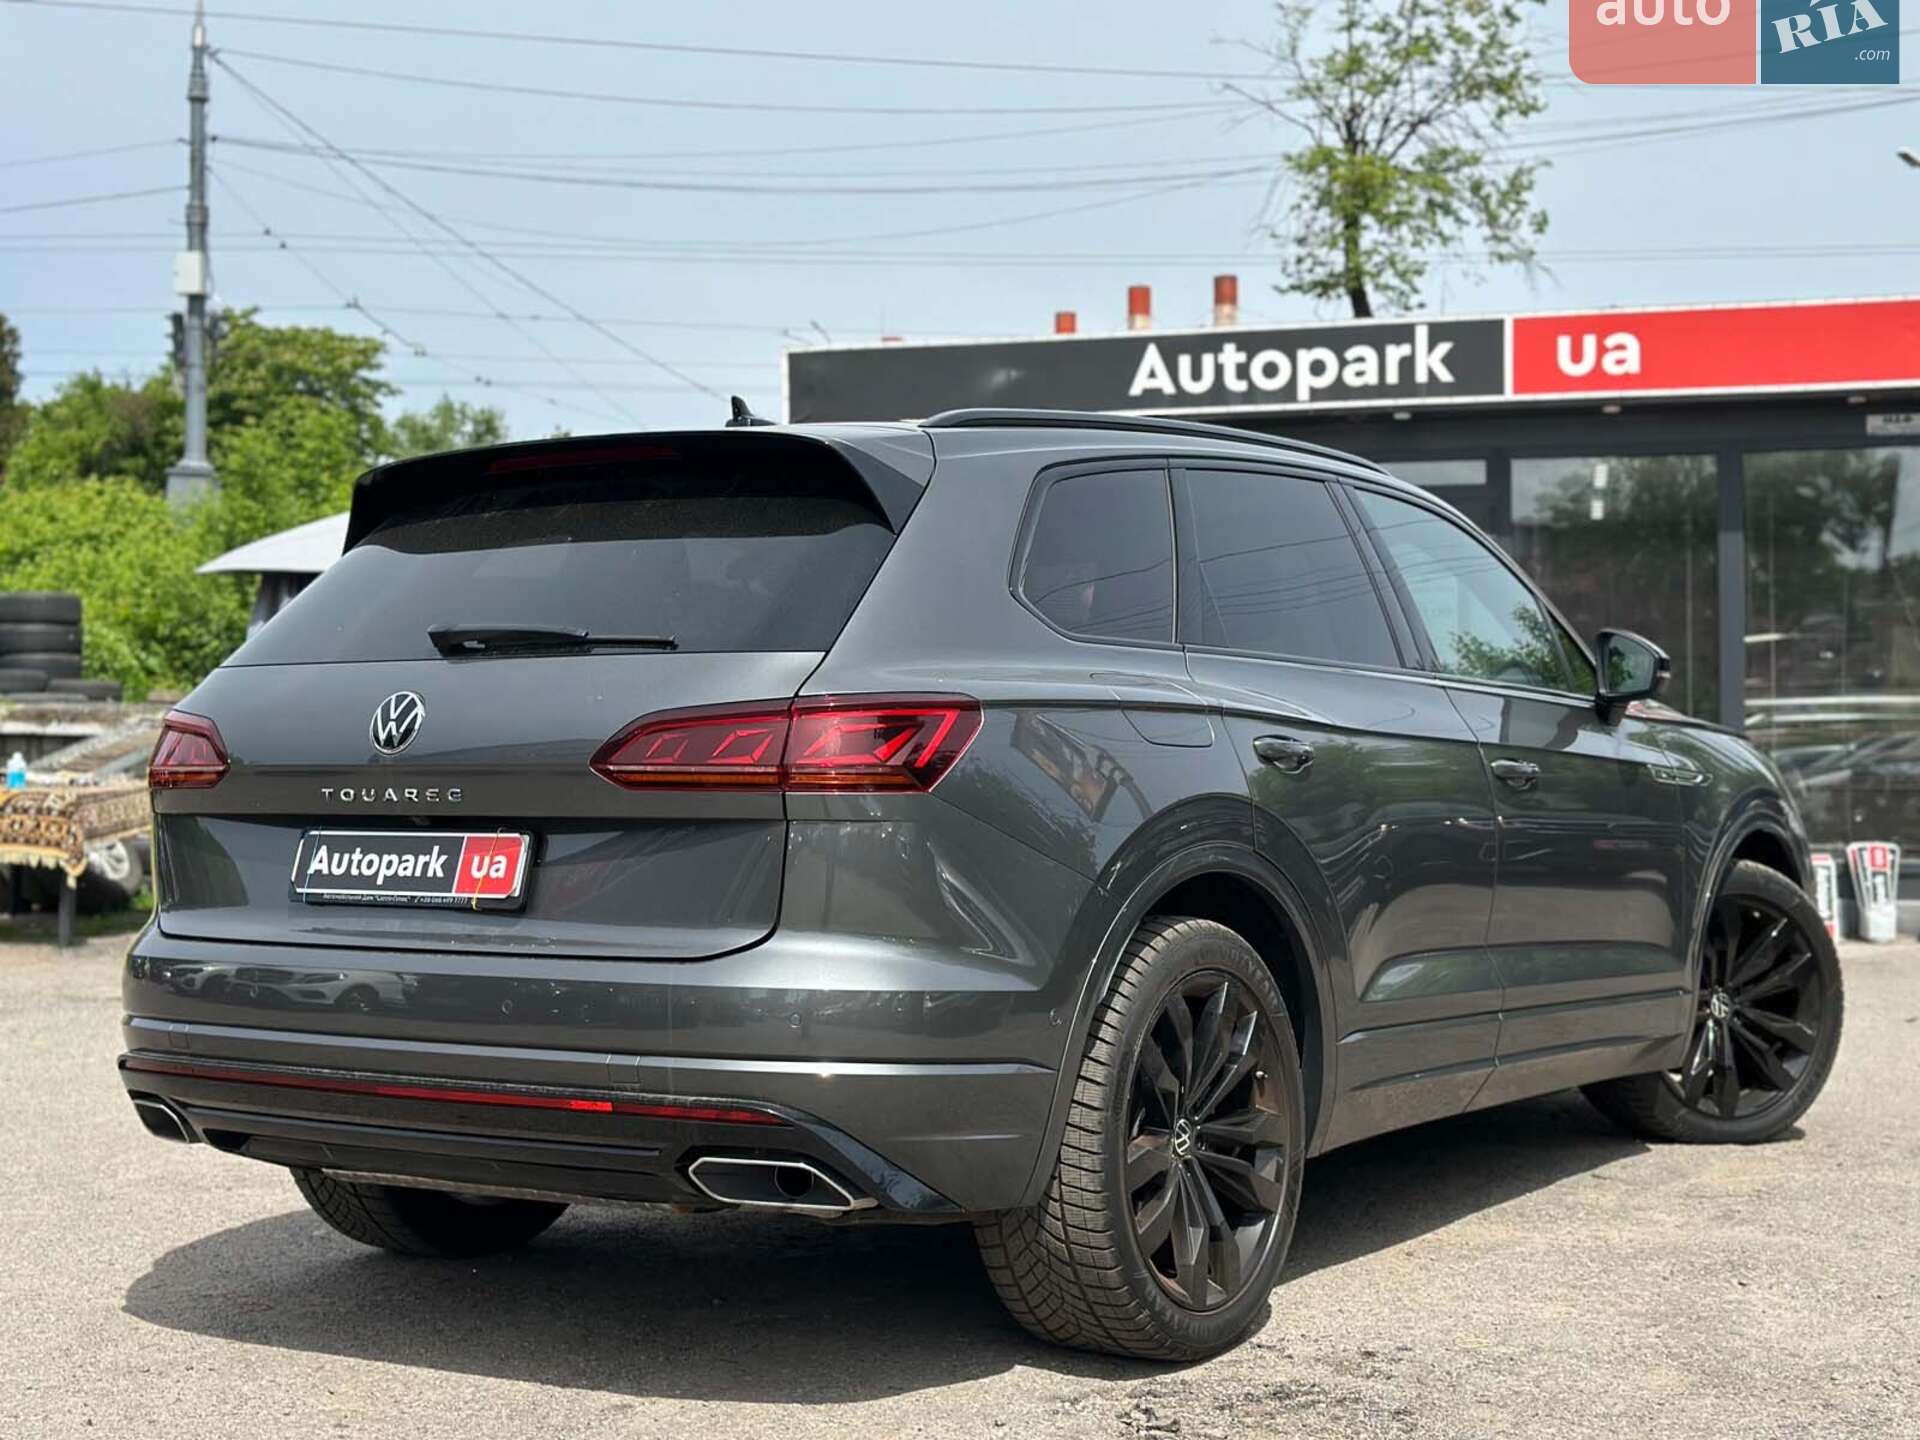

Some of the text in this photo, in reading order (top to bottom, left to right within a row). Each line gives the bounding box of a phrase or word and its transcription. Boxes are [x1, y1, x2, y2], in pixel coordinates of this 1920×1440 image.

[1128, 324, 1642, 401] Autopark ua
[321, 788, 464, 802] TOUAREG
[307, 845, 508, 885] Autopark ua
